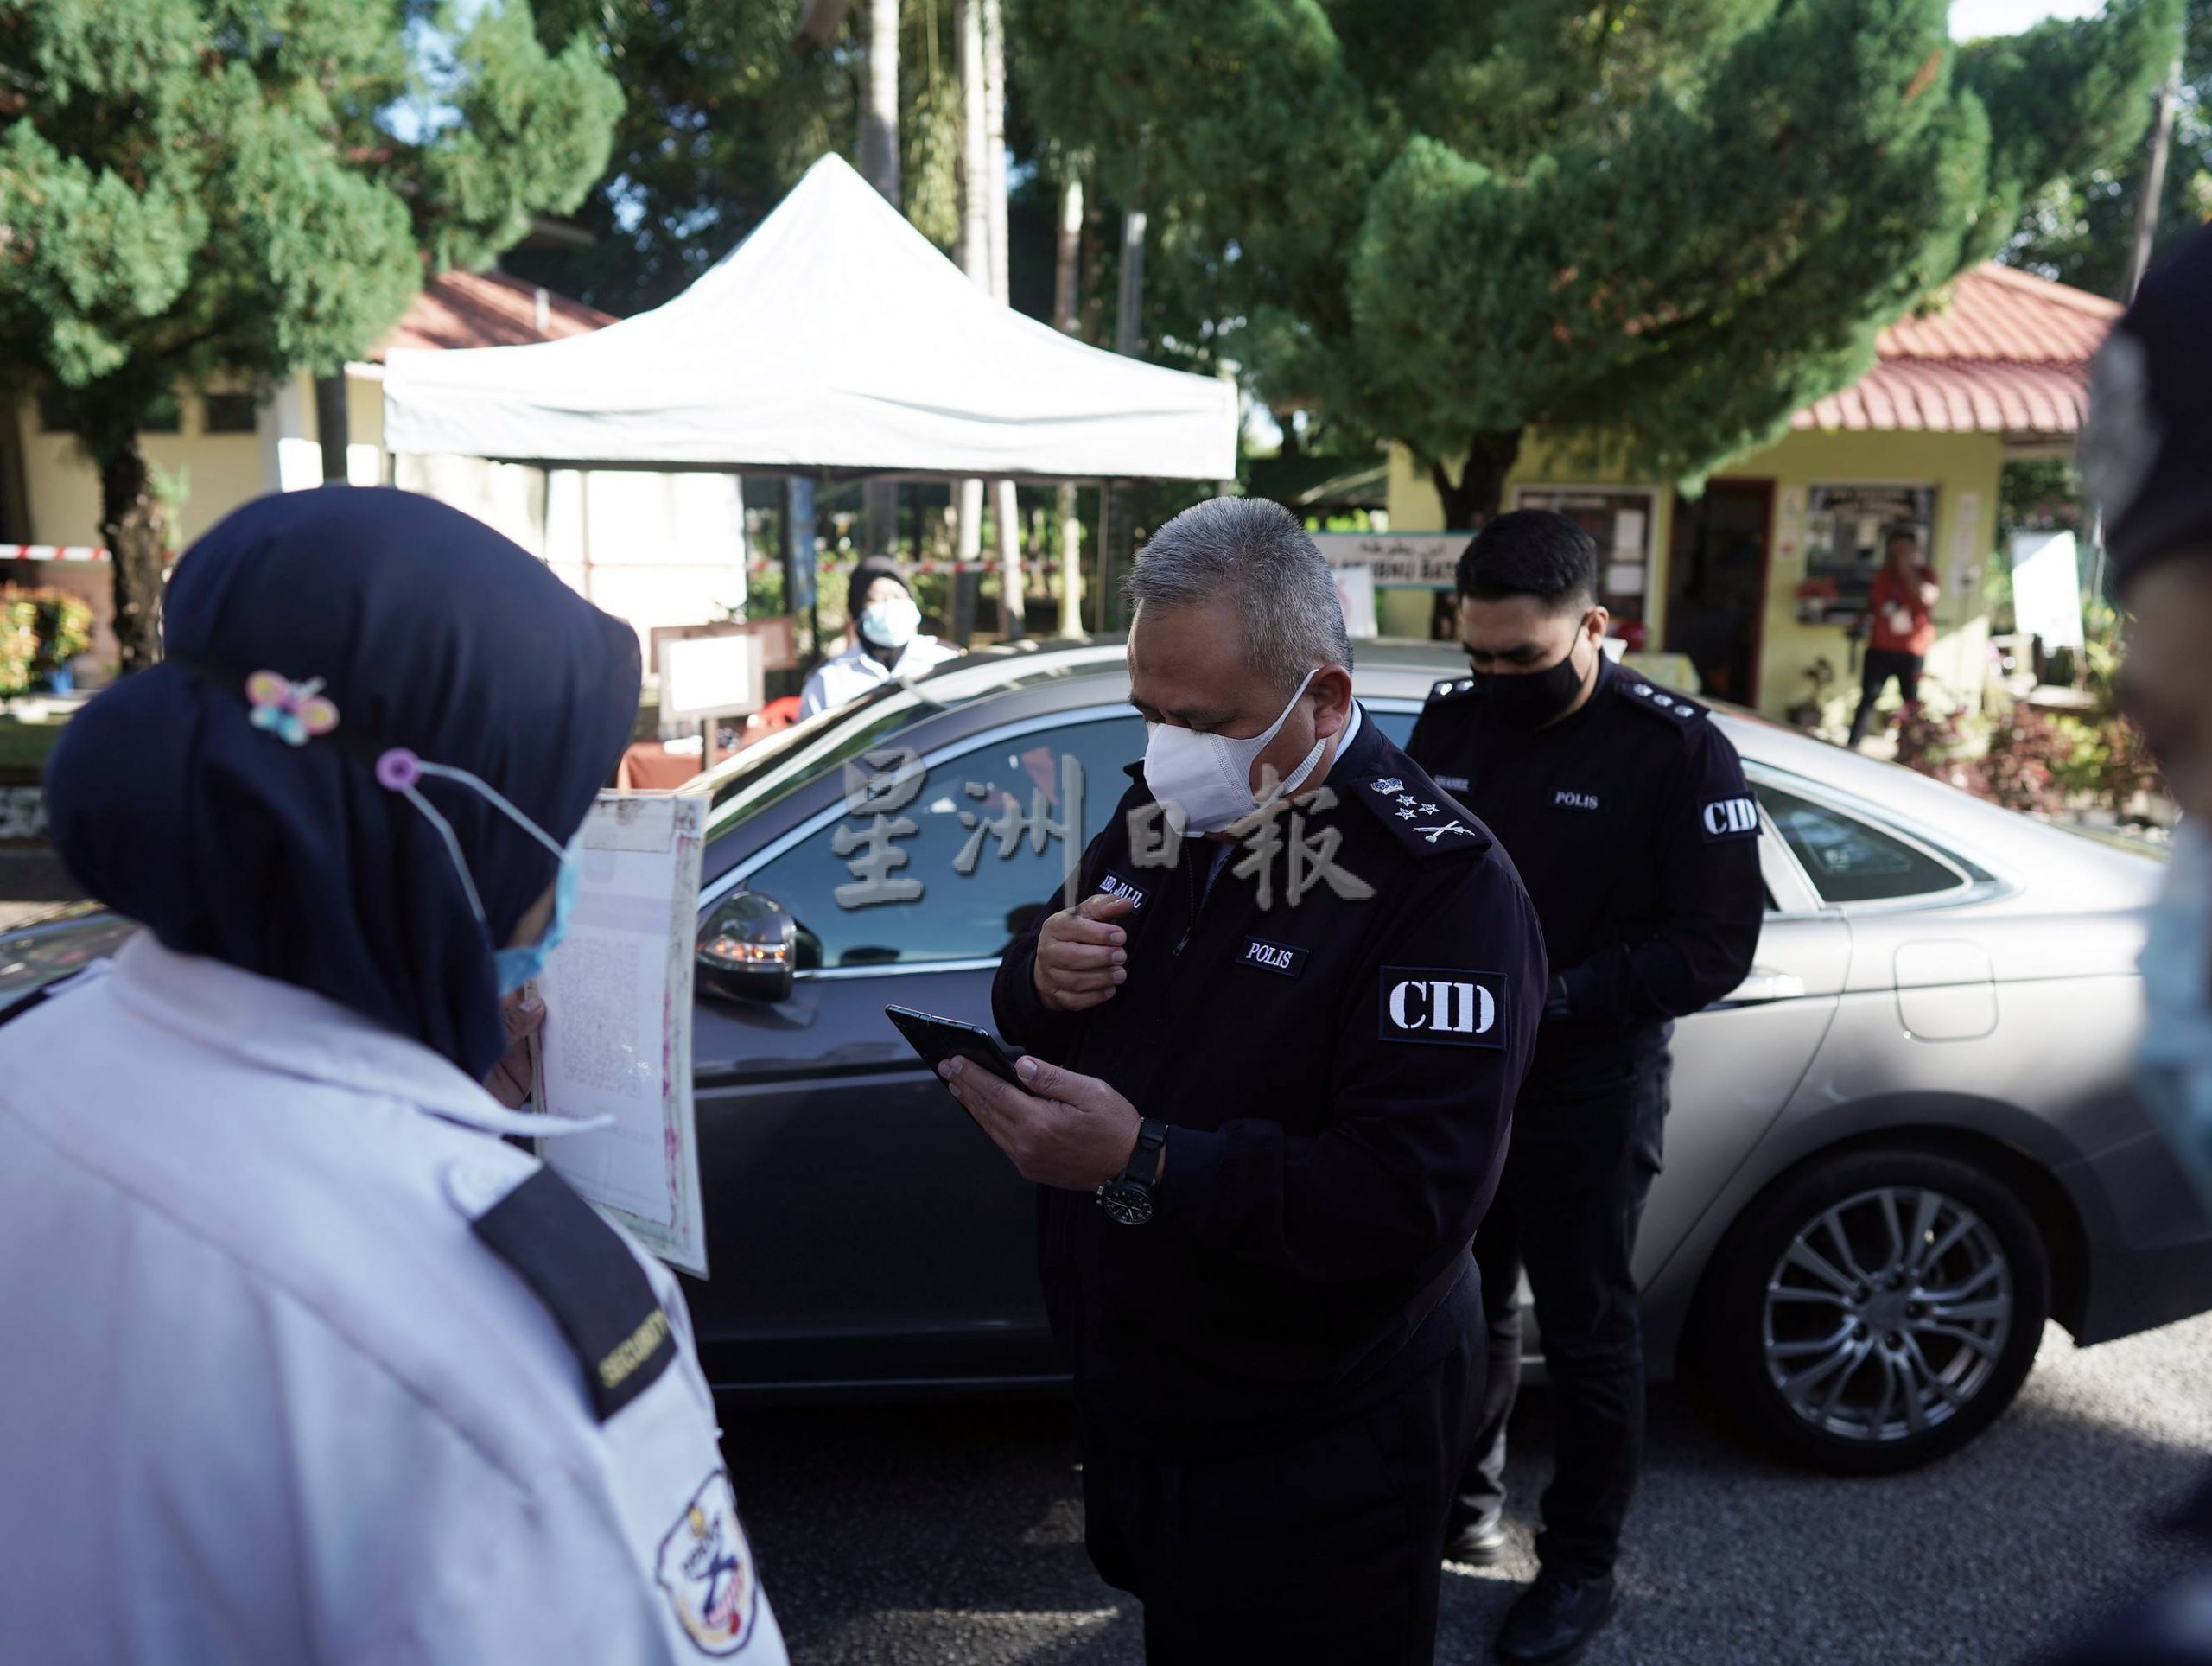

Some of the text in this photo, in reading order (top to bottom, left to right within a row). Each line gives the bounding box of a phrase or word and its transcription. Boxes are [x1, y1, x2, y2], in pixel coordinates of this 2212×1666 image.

[1554, 791, 1599, 810] POLIS
[1703, 798, 1758, 835] CID
[1113, 881, 1143, 909] JALIL
[1245, 942, 1294, 969] POLIS
[1389, 980, 1495, 1034] CID
